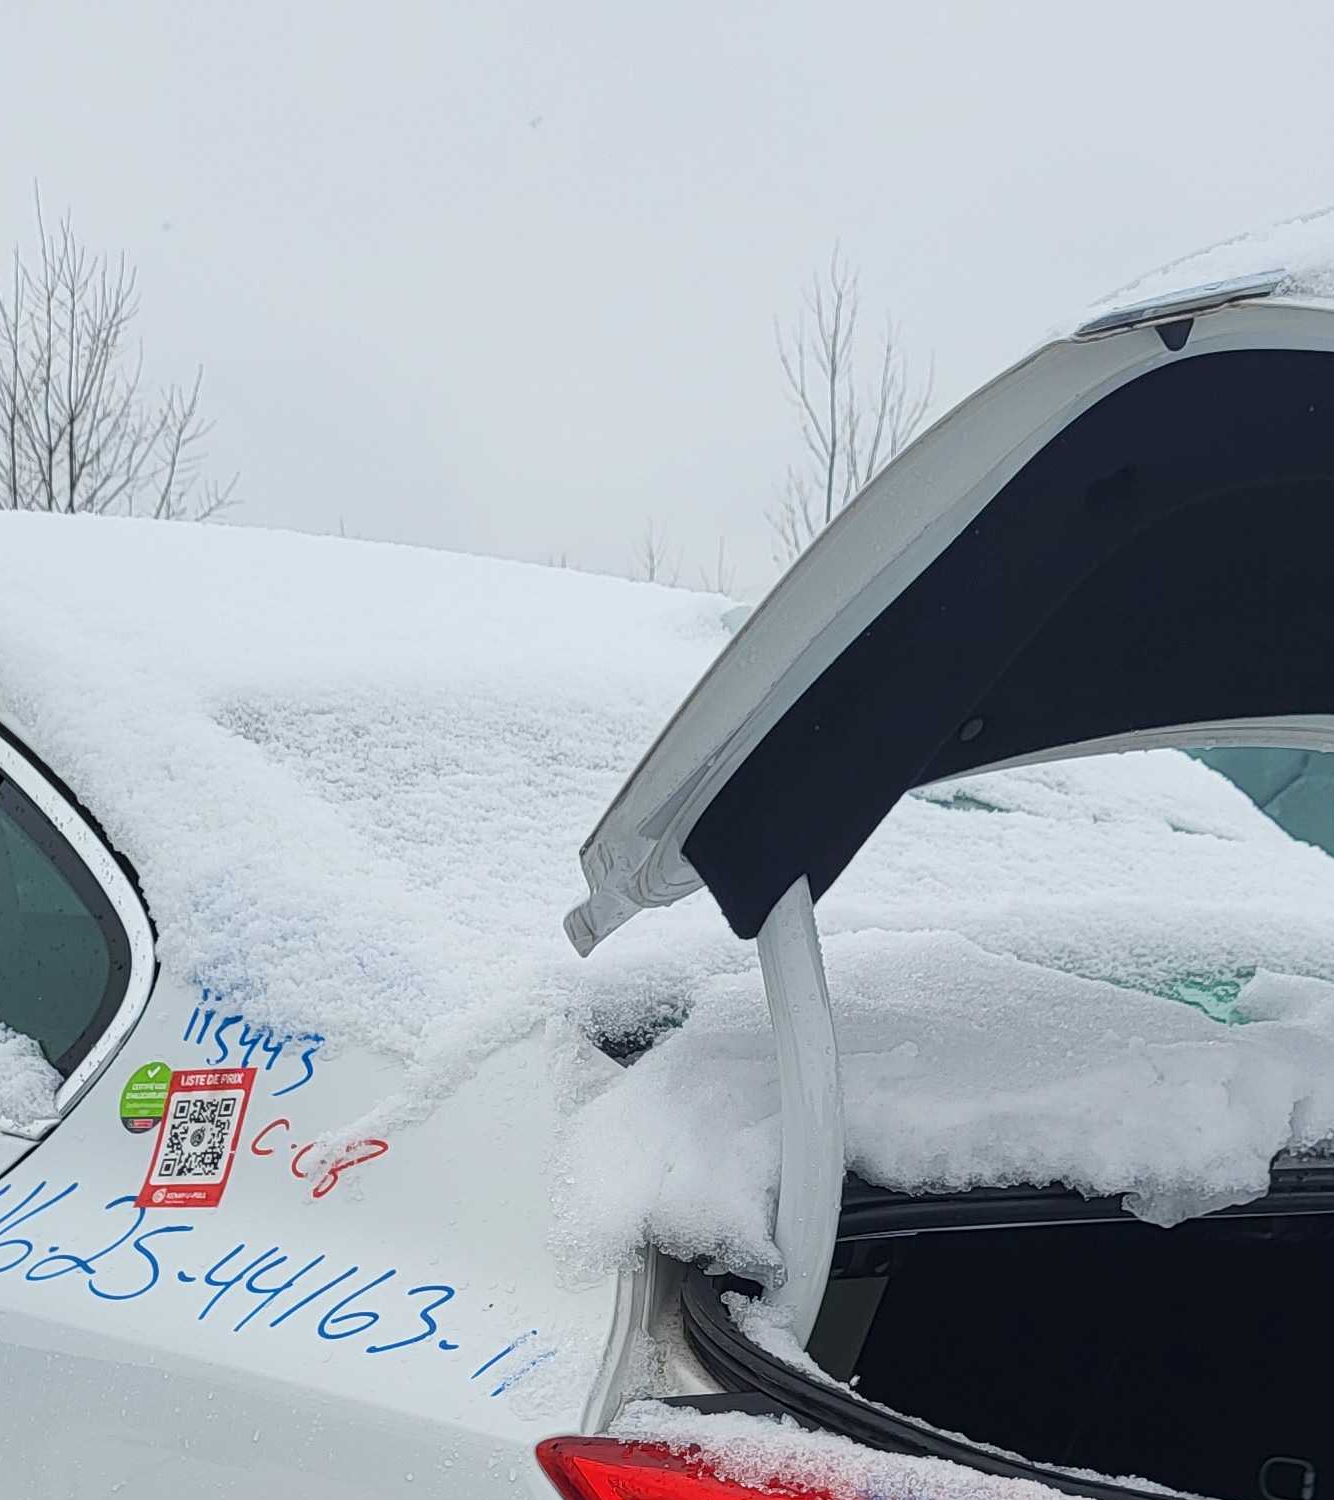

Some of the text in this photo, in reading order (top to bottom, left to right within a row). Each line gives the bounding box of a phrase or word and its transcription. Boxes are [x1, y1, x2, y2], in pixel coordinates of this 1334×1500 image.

[180, 1074, 205, 1087] LISTE
[206, 1073, 219, 1085] DE
[220, 1072, 245, 1085] PRIX
